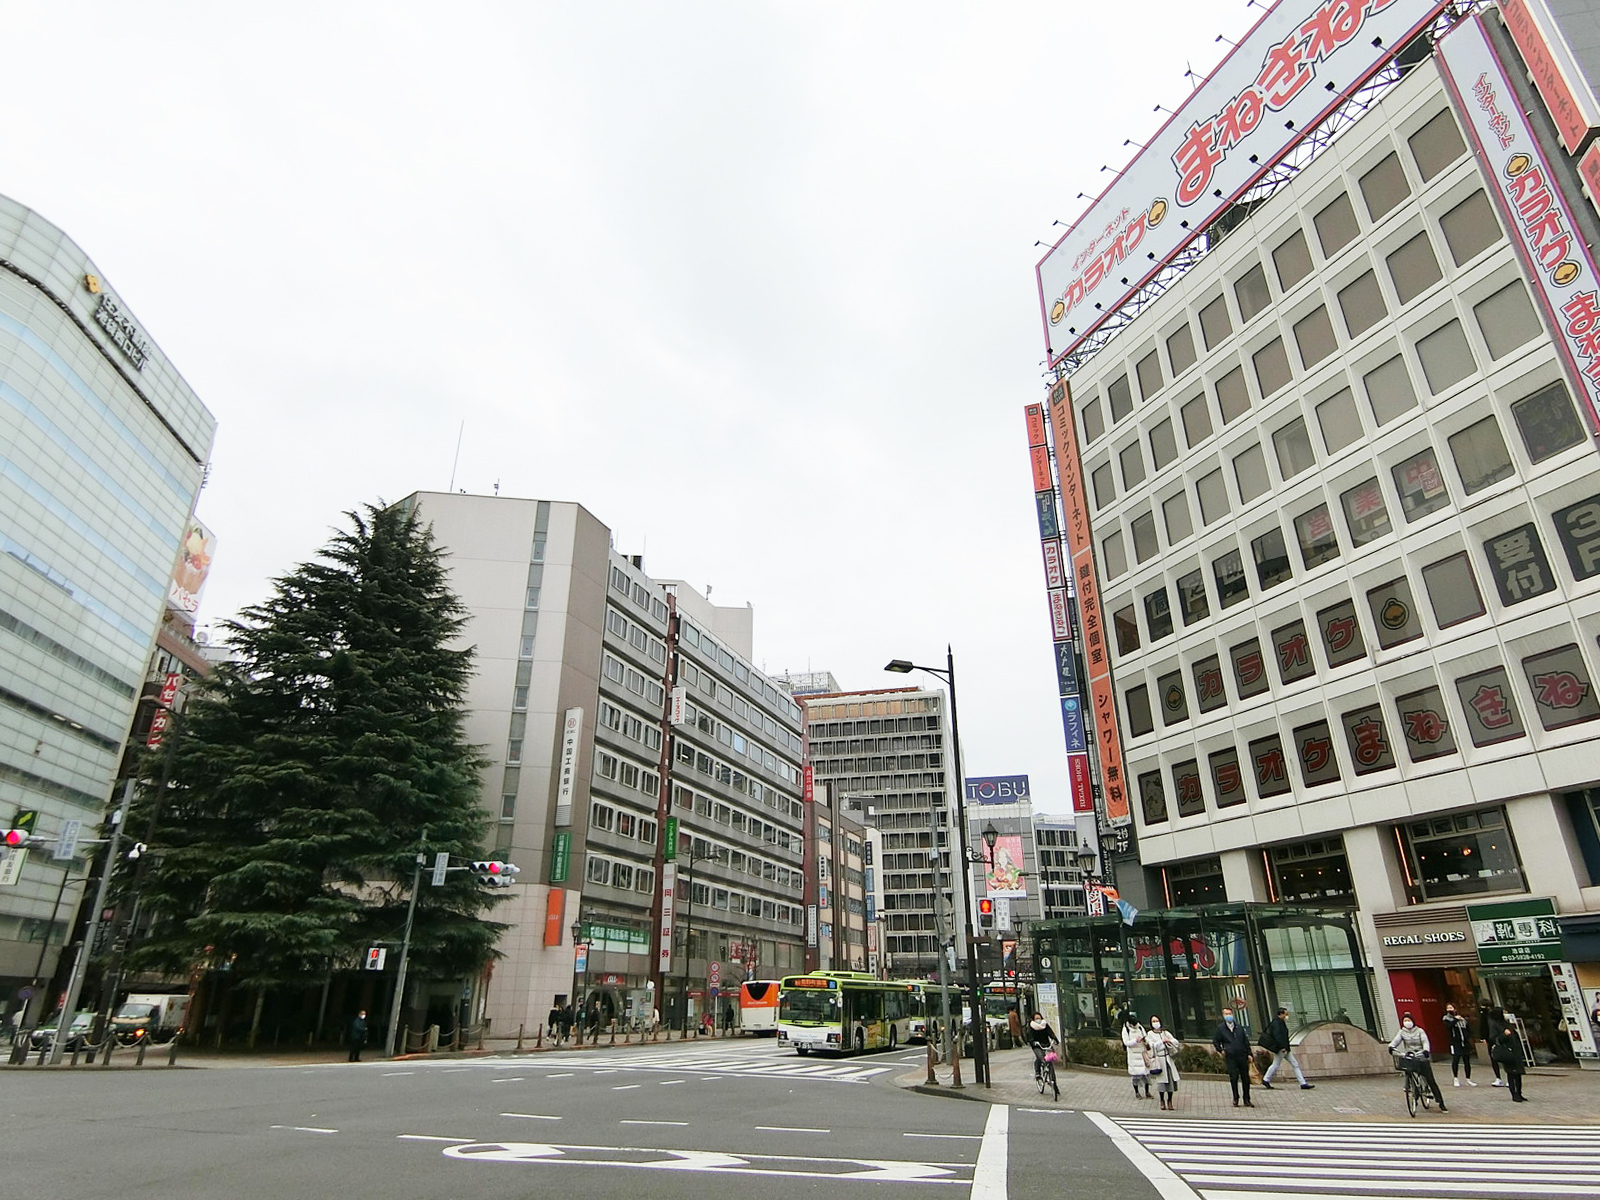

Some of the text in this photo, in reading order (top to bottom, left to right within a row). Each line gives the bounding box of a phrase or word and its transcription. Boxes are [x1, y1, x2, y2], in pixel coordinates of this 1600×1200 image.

[1171, 0, 1400, 207] まねきね
[1472, 72, 1515, 150] インターネット
[1071, 207, 1130, 271] インターネット
[1505, 164, 1573, 272] カラオケ
[1063, 209, 1148, 317] カラオケ
[1560, 290, 1600, 403] まね
[1046, 546, 1059, 584] カラオケ
[1493, 503, 1600, 600] 受付 3F
[1198, 613, 1357, 700] カラオケ
[1067, 711, 1081, 749] ラフィネ
[1098, 694, 1123, 803] シャワー無料
[967, 780, 1026, 799] TOBU
[661, 888, 673, 958] 岡三証券
[1383, 931, 1466, 947] REGAL SHOES
